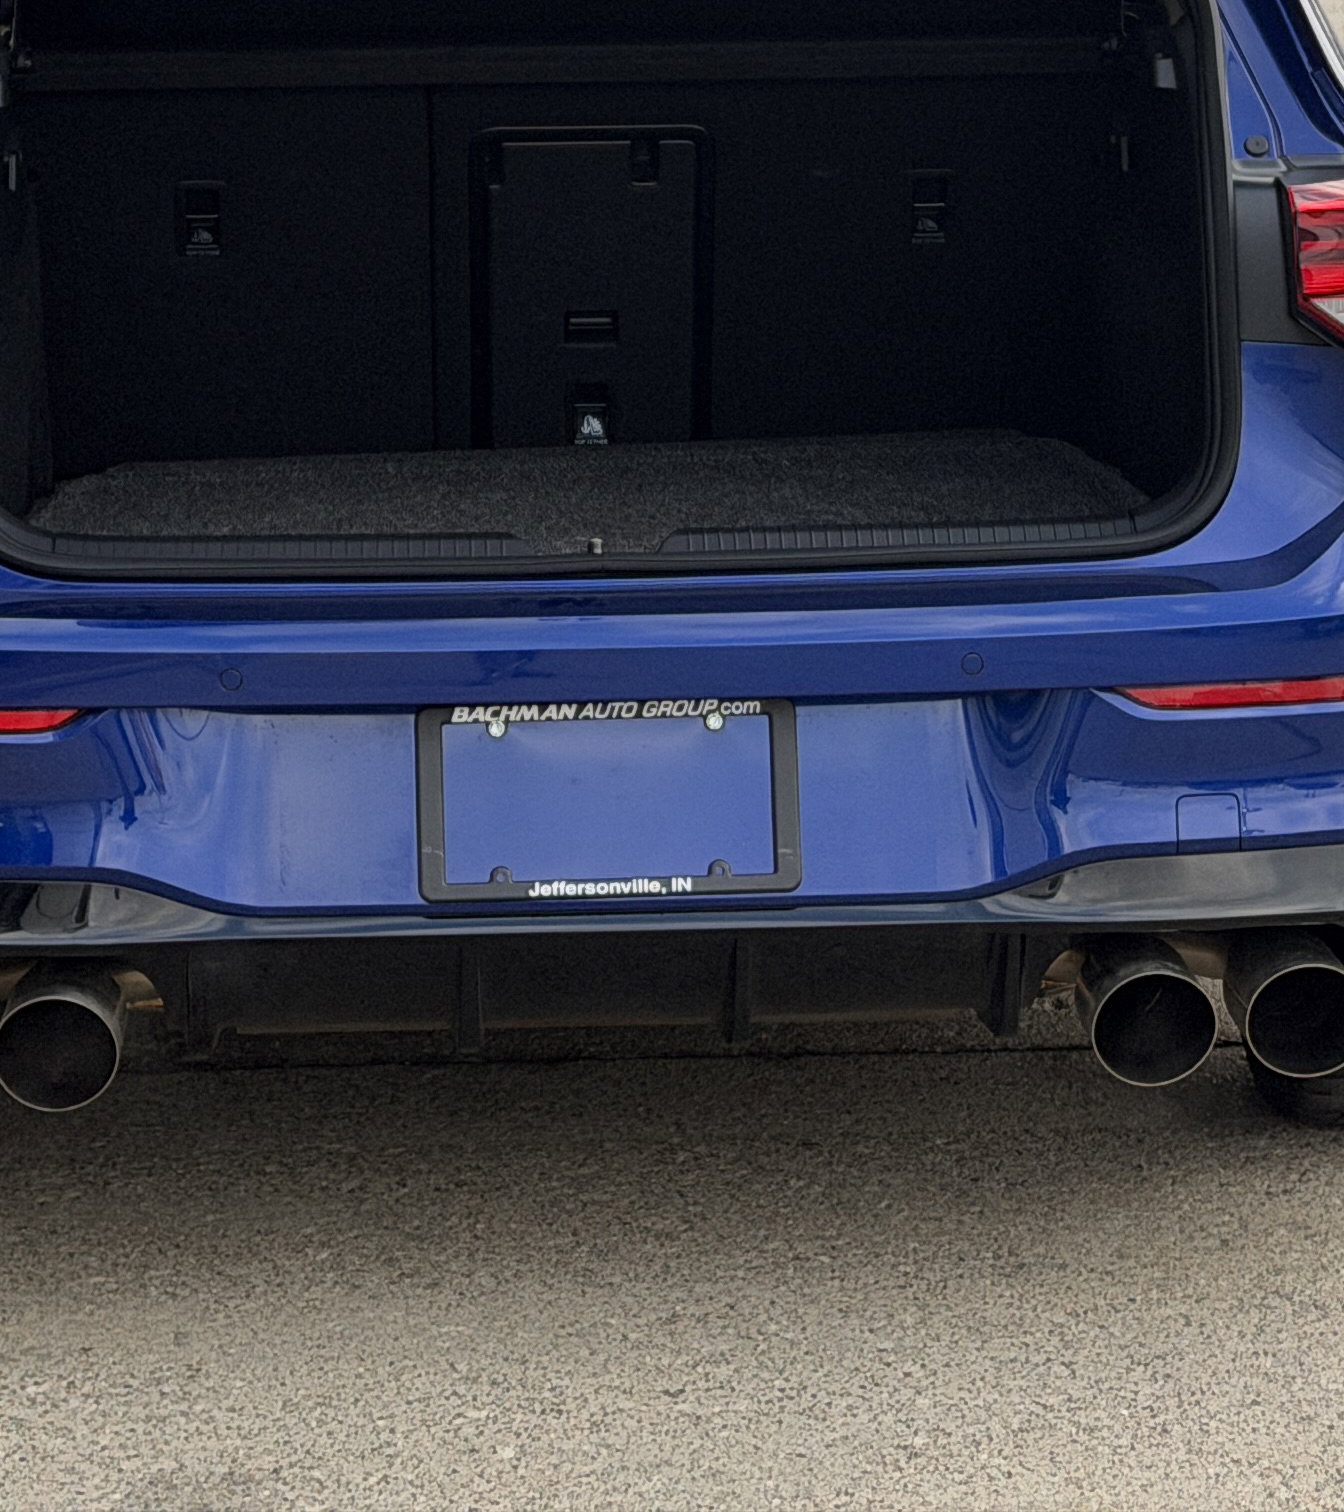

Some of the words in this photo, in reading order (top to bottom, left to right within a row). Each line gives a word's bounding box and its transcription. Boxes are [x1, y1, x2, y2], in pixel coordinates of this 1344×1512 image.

[451, 703, 577, 723] BACHMAN
[578, 701, 639, 719] AUTO
[528, 878, 667, 897] Jeffersonville,
[671, 877, 692, 893] IN
